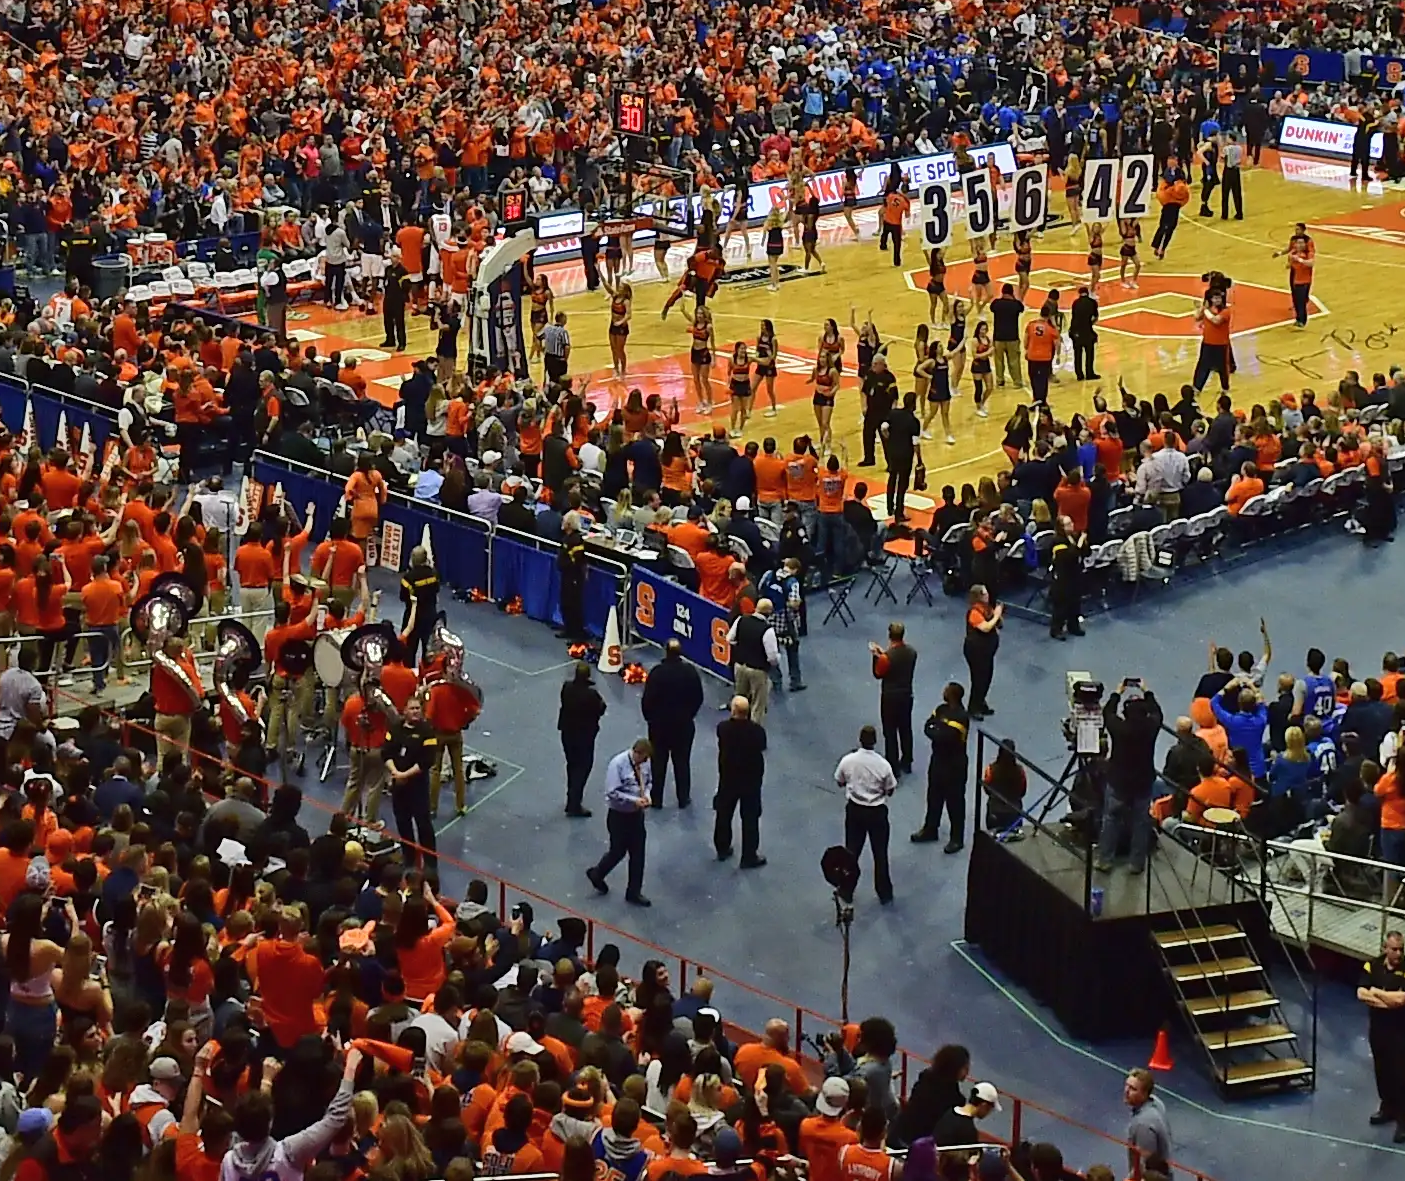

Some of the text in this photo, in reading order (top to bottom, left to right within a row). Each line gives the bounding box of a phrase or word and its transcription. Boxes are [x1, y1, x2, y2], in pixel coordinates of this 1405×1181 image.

[620, 108, 641, 131] 30
[1285, 125, 1344, 145] DUNKIN'
[967, 173, 989, 229] 5
[1015, 169, 1042, 227] 6
[1089, 165, 1113, 216] 4
[1123, 160, 1148, 214] 2
[924, 188, 947, 242] 3
[635, 581, 656, 628] S
[607, 645, 622, 666] S
[710, 617, 732, 666] S
[1313, 696, 1333, 716] 40
